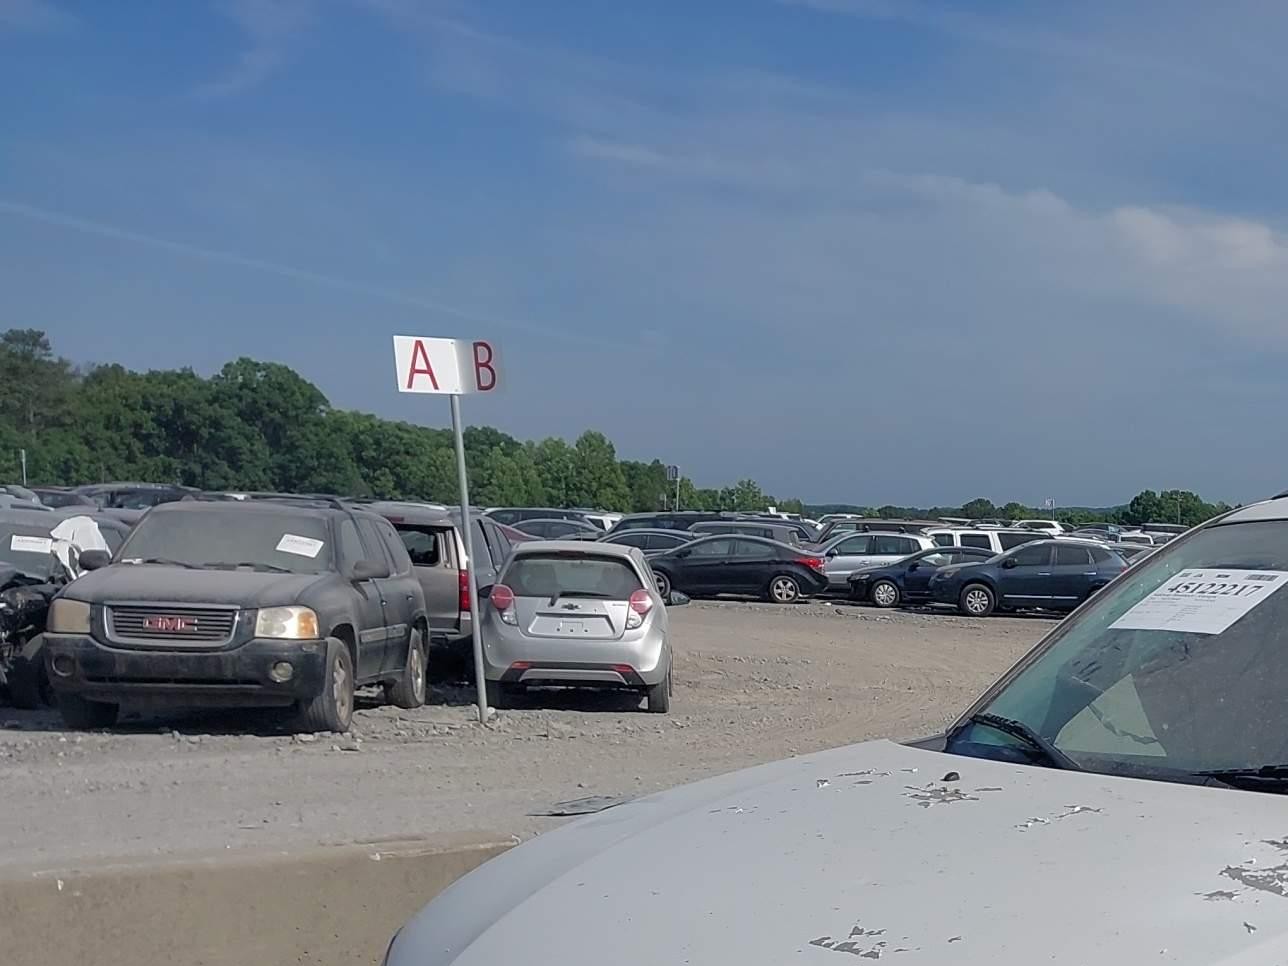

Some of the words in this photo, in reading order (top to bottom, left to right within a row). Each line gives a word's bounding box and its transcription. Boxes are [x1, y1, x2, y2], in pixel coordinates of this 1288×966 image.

[407, 340, 440, 390] A
[473, 341, 496, 391] B
[1168, 582, 1264, 597] 45122217
[143, 615, 198, 632] GMC
